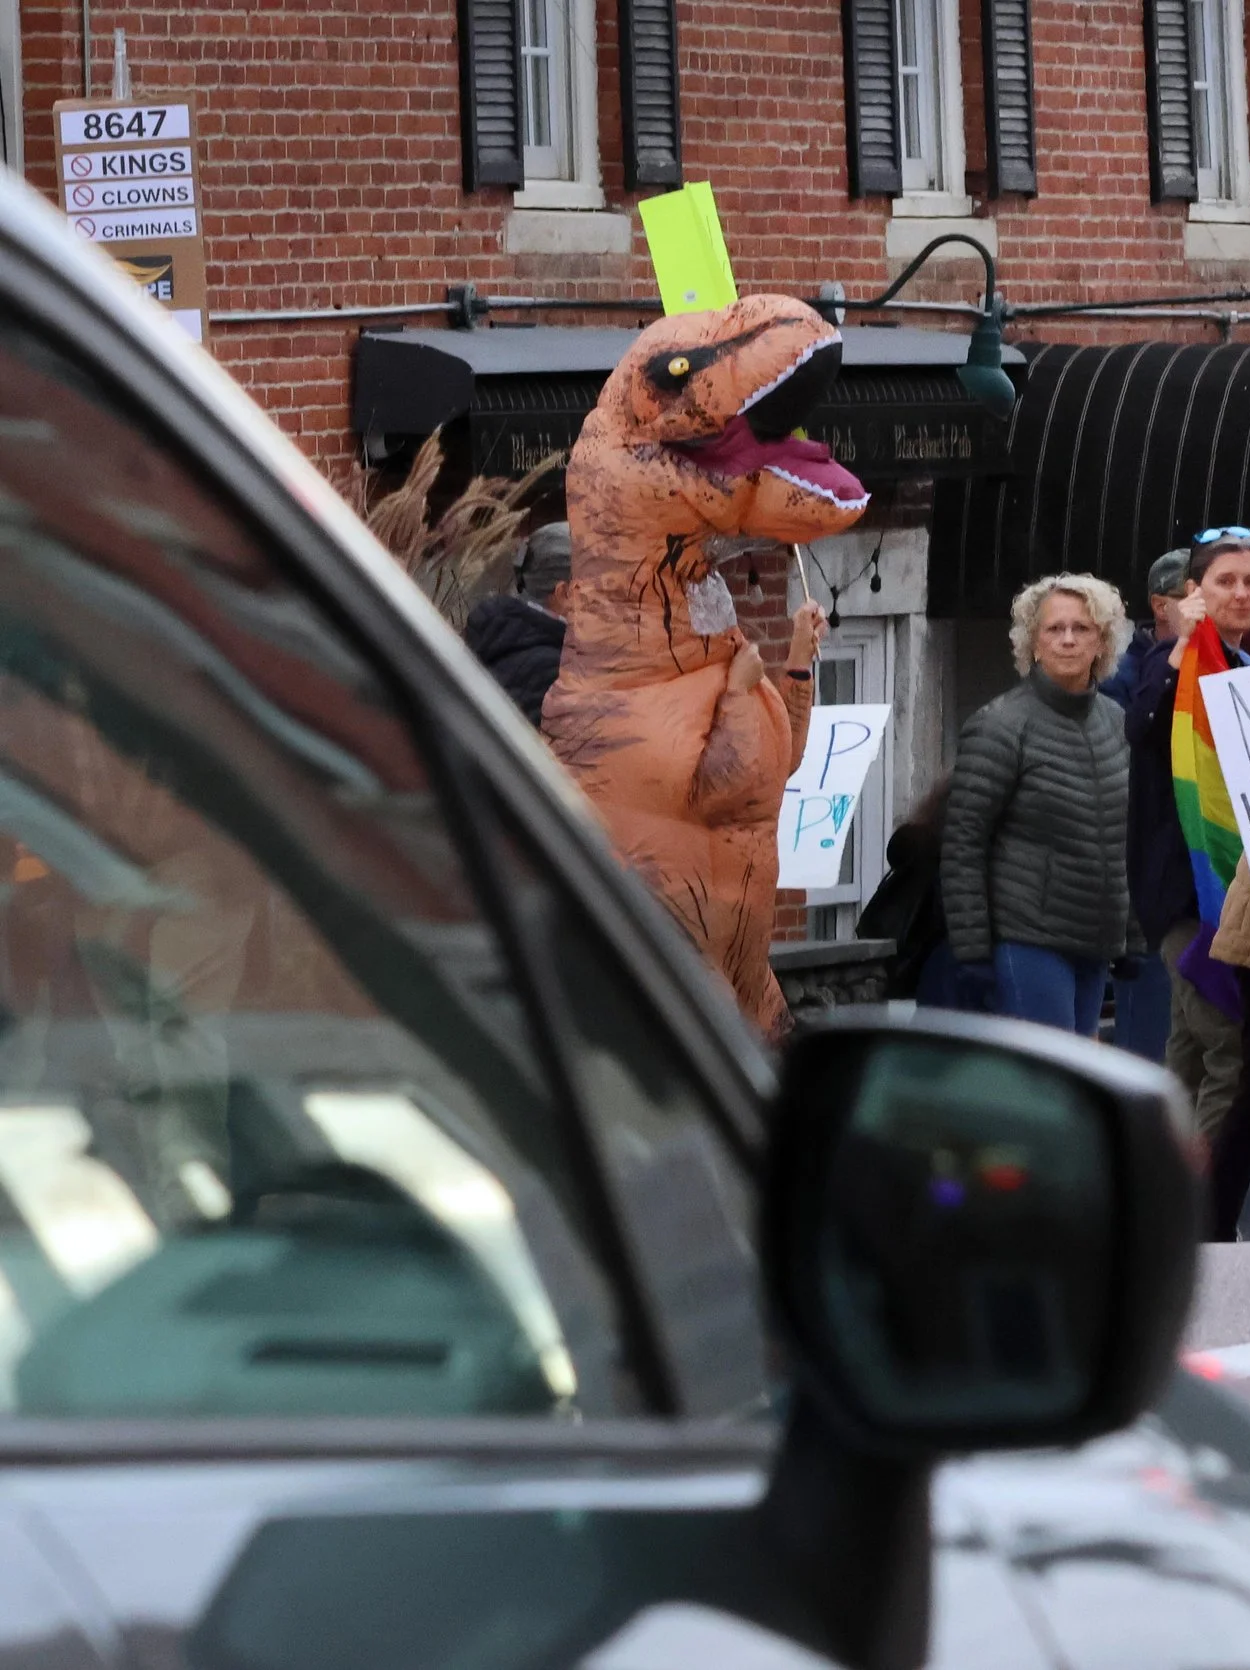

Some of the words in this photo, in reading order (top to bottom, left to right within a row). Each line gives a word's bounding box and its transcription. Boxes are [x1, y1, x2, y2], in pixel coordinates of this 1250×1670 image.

[83, 110, 168, 140] 8647
[102, 152, 186, 176] KINGS
[102, 186, 189, 205] CLOWNS
[102, 219, 193, 238] CRIMINALS
[831, 425, 857, 462] Pub
[950, 423, 972, 459] Pub
